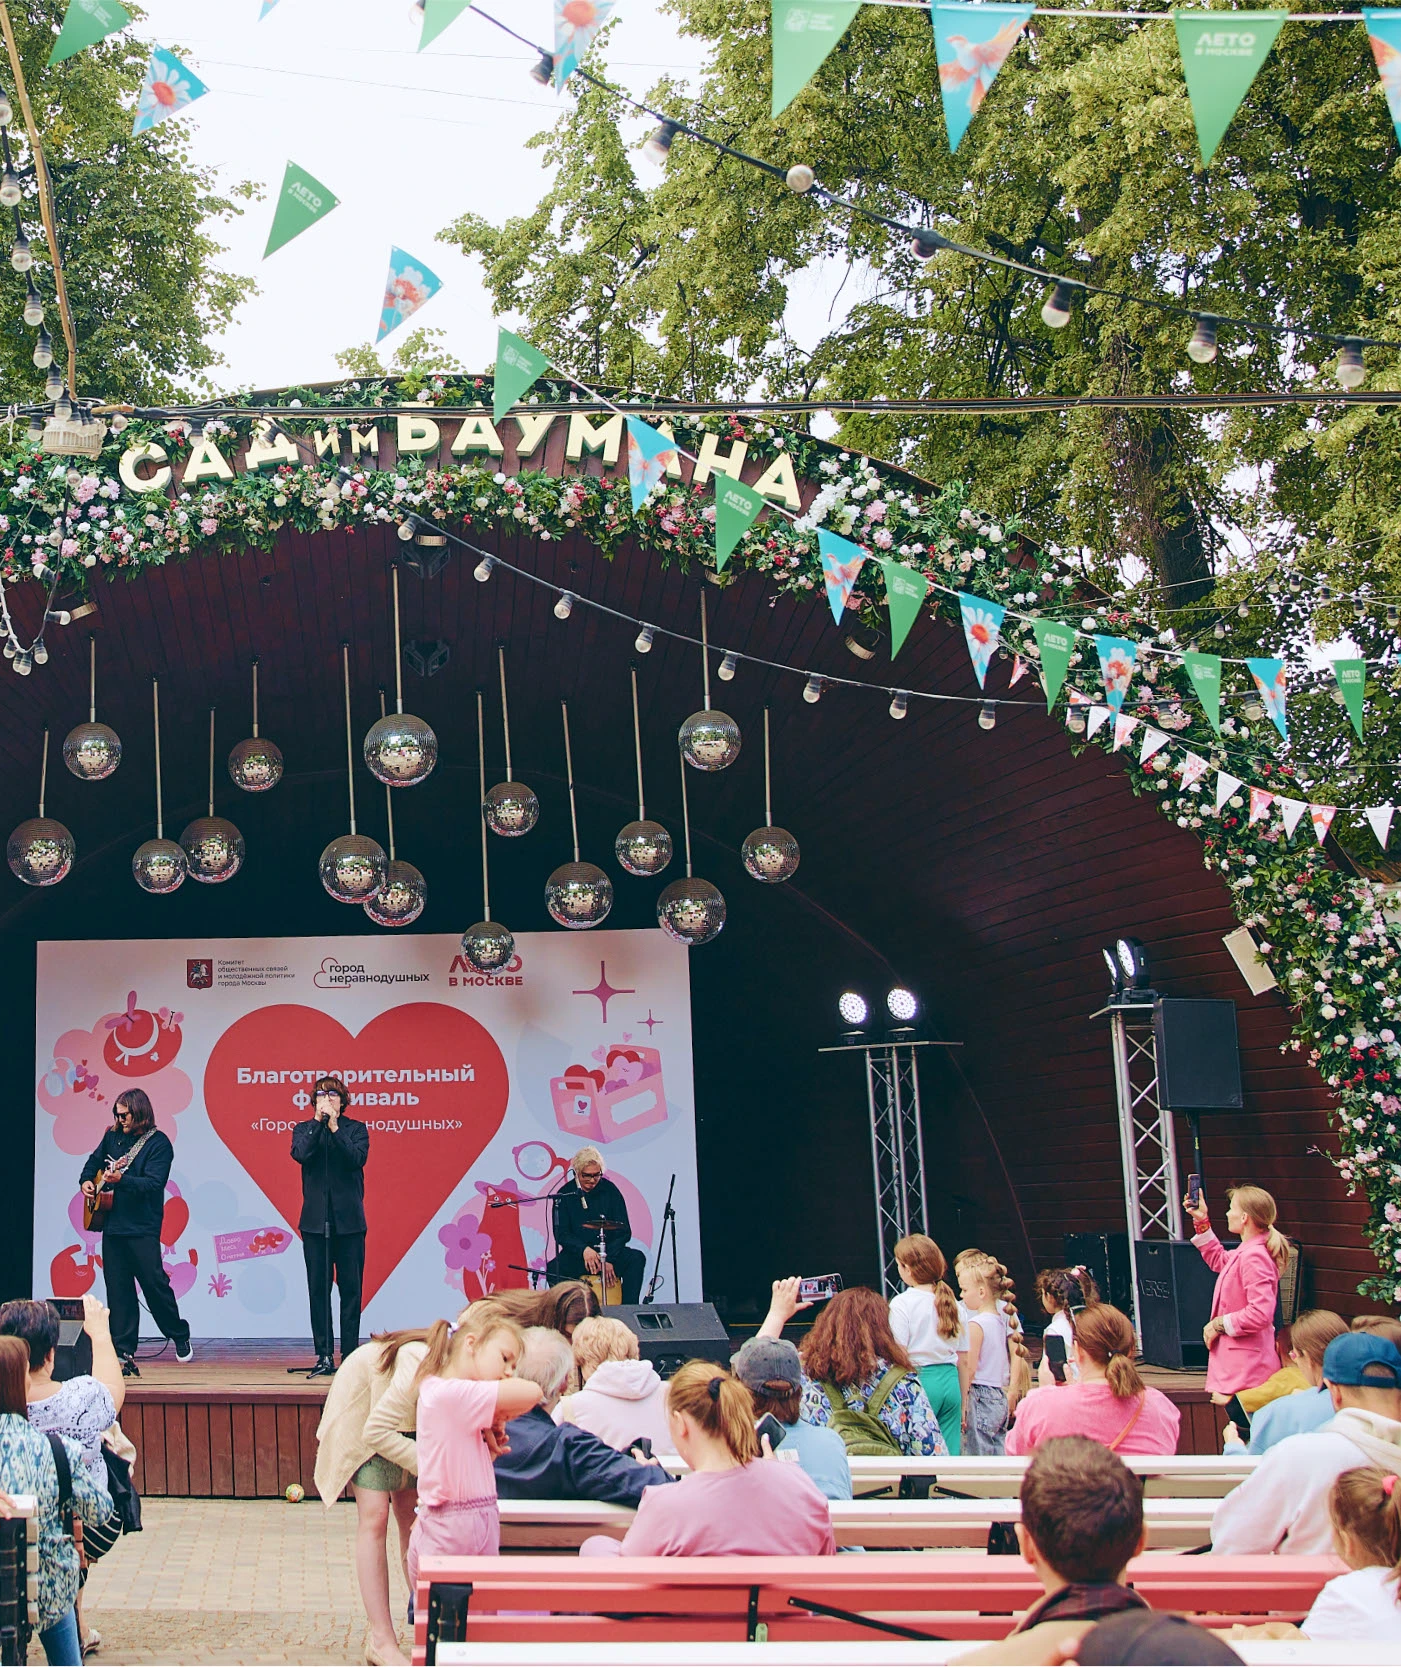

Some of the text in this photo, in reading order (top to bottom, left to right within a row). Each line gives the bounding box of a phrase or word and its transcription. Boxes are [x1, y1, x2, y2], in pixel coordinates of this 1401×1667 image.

[1196, 33, 1256, 46] ЛЕТО
[291, 181, 323, 208] ЛЕТО
[118, 414, 299, 493] САД
[313, 426, 378, 456] ИМ
[725, 490, 752, 510] ЛЕТО
[330, 964, 365, 974] город
[449, 955, 523, 973] ЛО
[330, 974, 430, 985] неравнодушных
[449, 977, 523, 987] В МОСКВЕ
[237, 1064, 475, 1086] Благотворительный
[292, 1089, 420, 1111] фиваль
[251, 1118, 463, 1135] «Горо нодушных»
